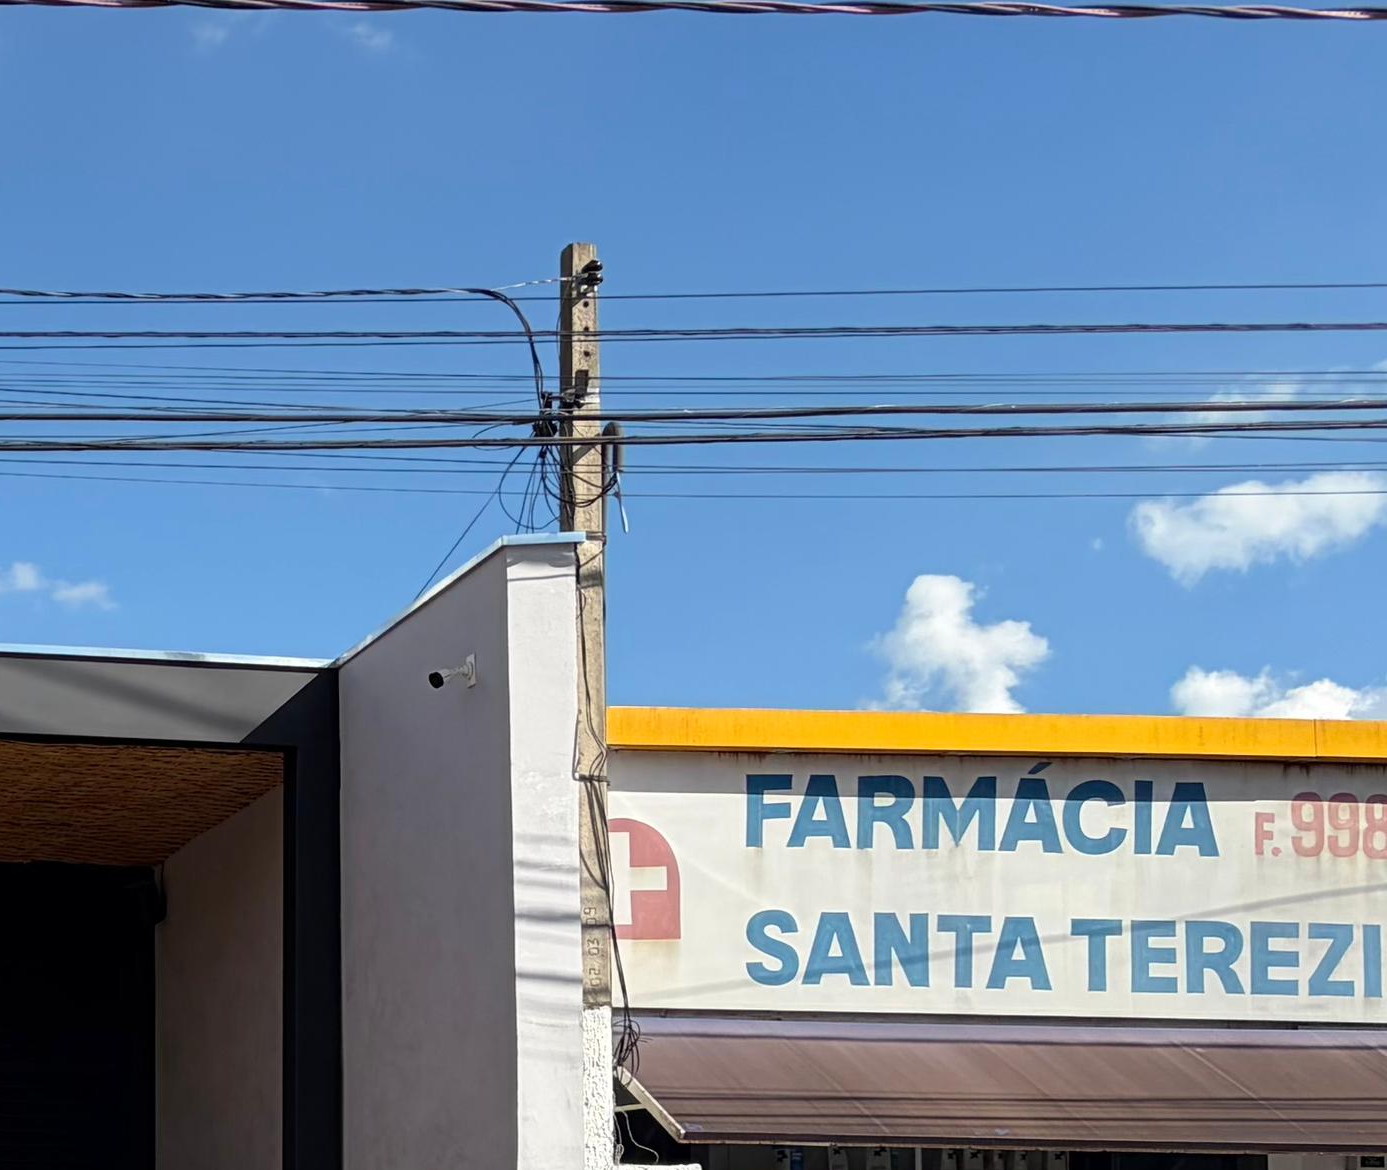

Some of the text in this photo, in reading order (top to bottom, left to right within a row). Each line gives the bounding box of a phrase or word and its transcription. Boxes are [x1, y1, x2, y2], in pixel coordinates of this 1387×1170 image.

[744, 761, 1220, 858] FARMÁCIA
[744, 907, 1383, 998] SANTA TEREZI
